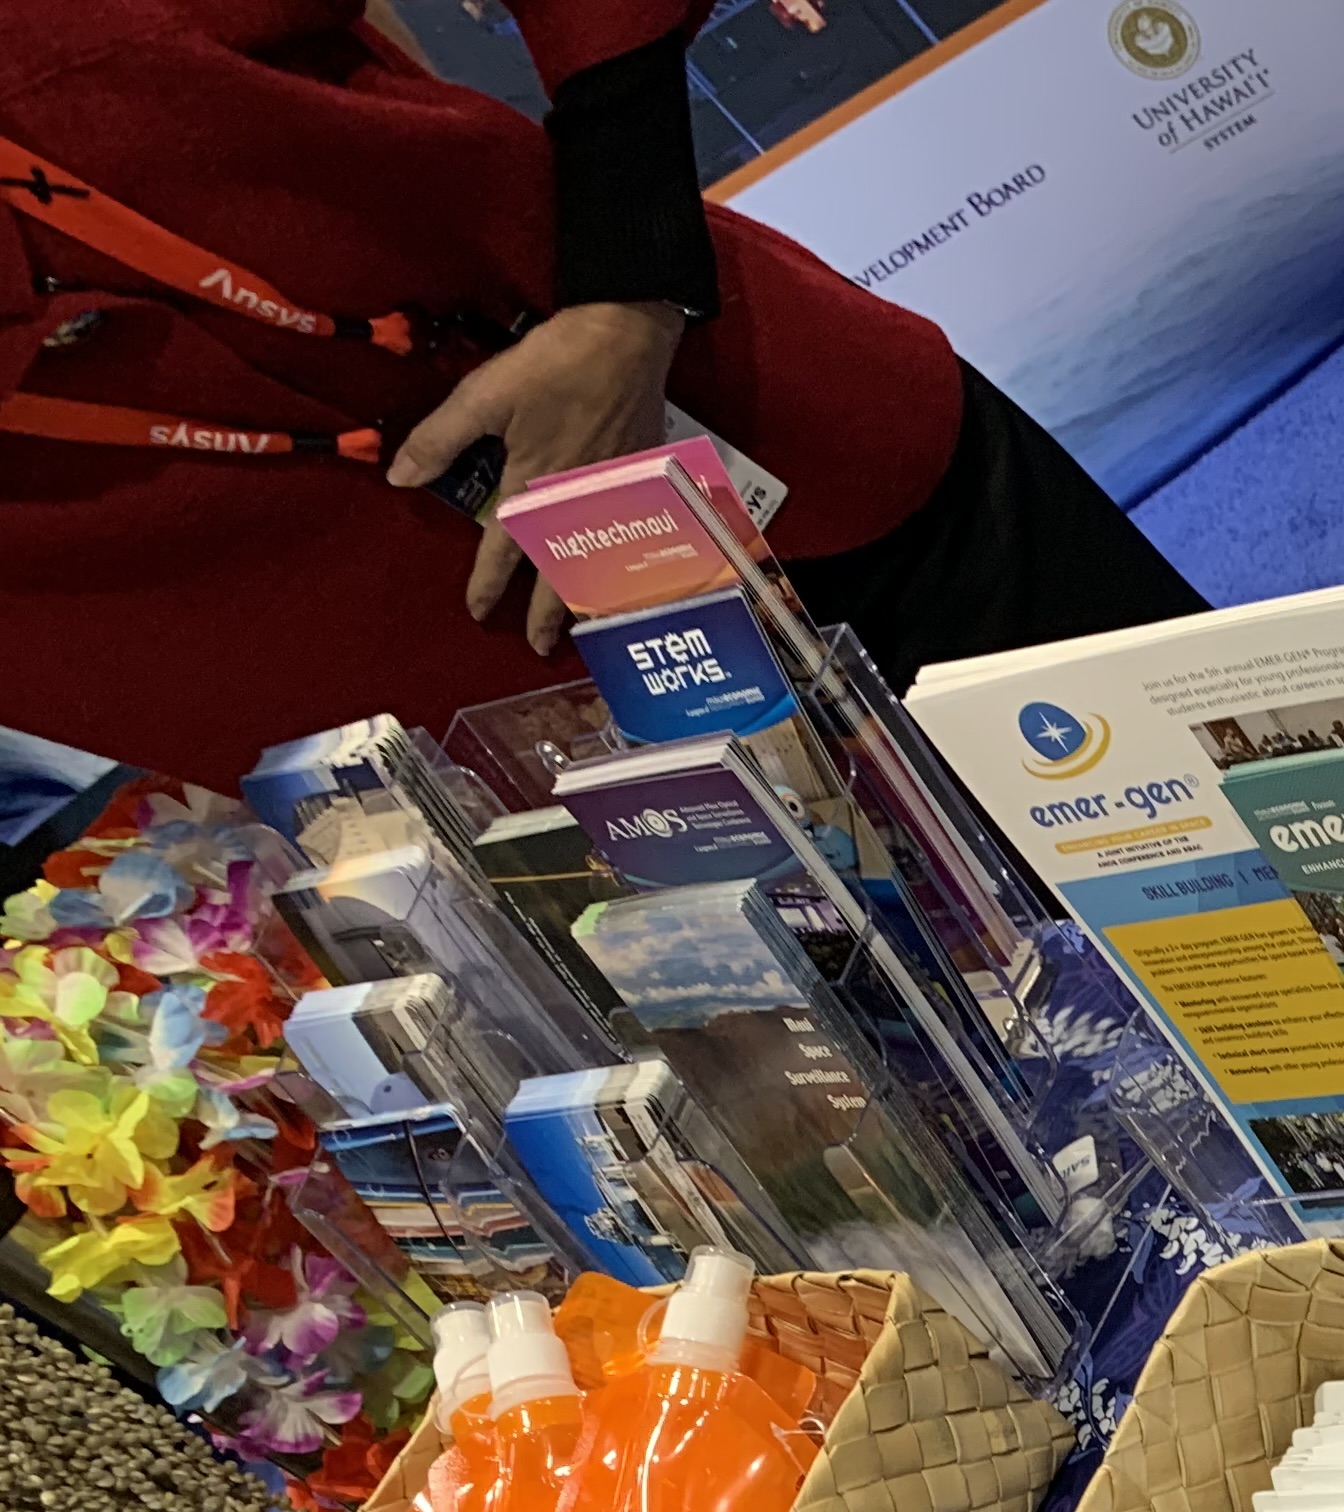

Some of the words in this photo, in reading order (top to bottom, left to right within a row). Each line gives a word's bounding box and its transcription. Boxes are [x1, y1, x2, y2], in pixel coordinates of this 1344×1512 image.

[1132, 48, 1258, 130] UNIVERSITY
[1158, 120, 1179, 147] of
[1203, 114, 1257, 151] SYSTEM
[853, 208, 970, 288] VELOPMENT
[965, 163, 1047, 218] BOARD
[199, 268, 317, 334] Ansys
[149, 422, 271, 454] Ansys
[545, 508, 679, 562] hightechmaui
[1141, 680, 1162, 691] Join
[1161, 678, 1174, 687] us
[1171, 673, 1188, 684] for
[1187, 670, 1205, 681] the
[1221, 658, 1255, 675] annual
[605, 808, 688, 841] AMOS
[1141, 882, 1180, 901] SKILL
[1180, 873, 1234, 897] BUILDING
[783, 1016, 816, 1033] Maui
[798, 1043, 833, 1060] Space
[784, 1069, 850, 1086] Surveillance
[826, 1094, 867, 1111] System
